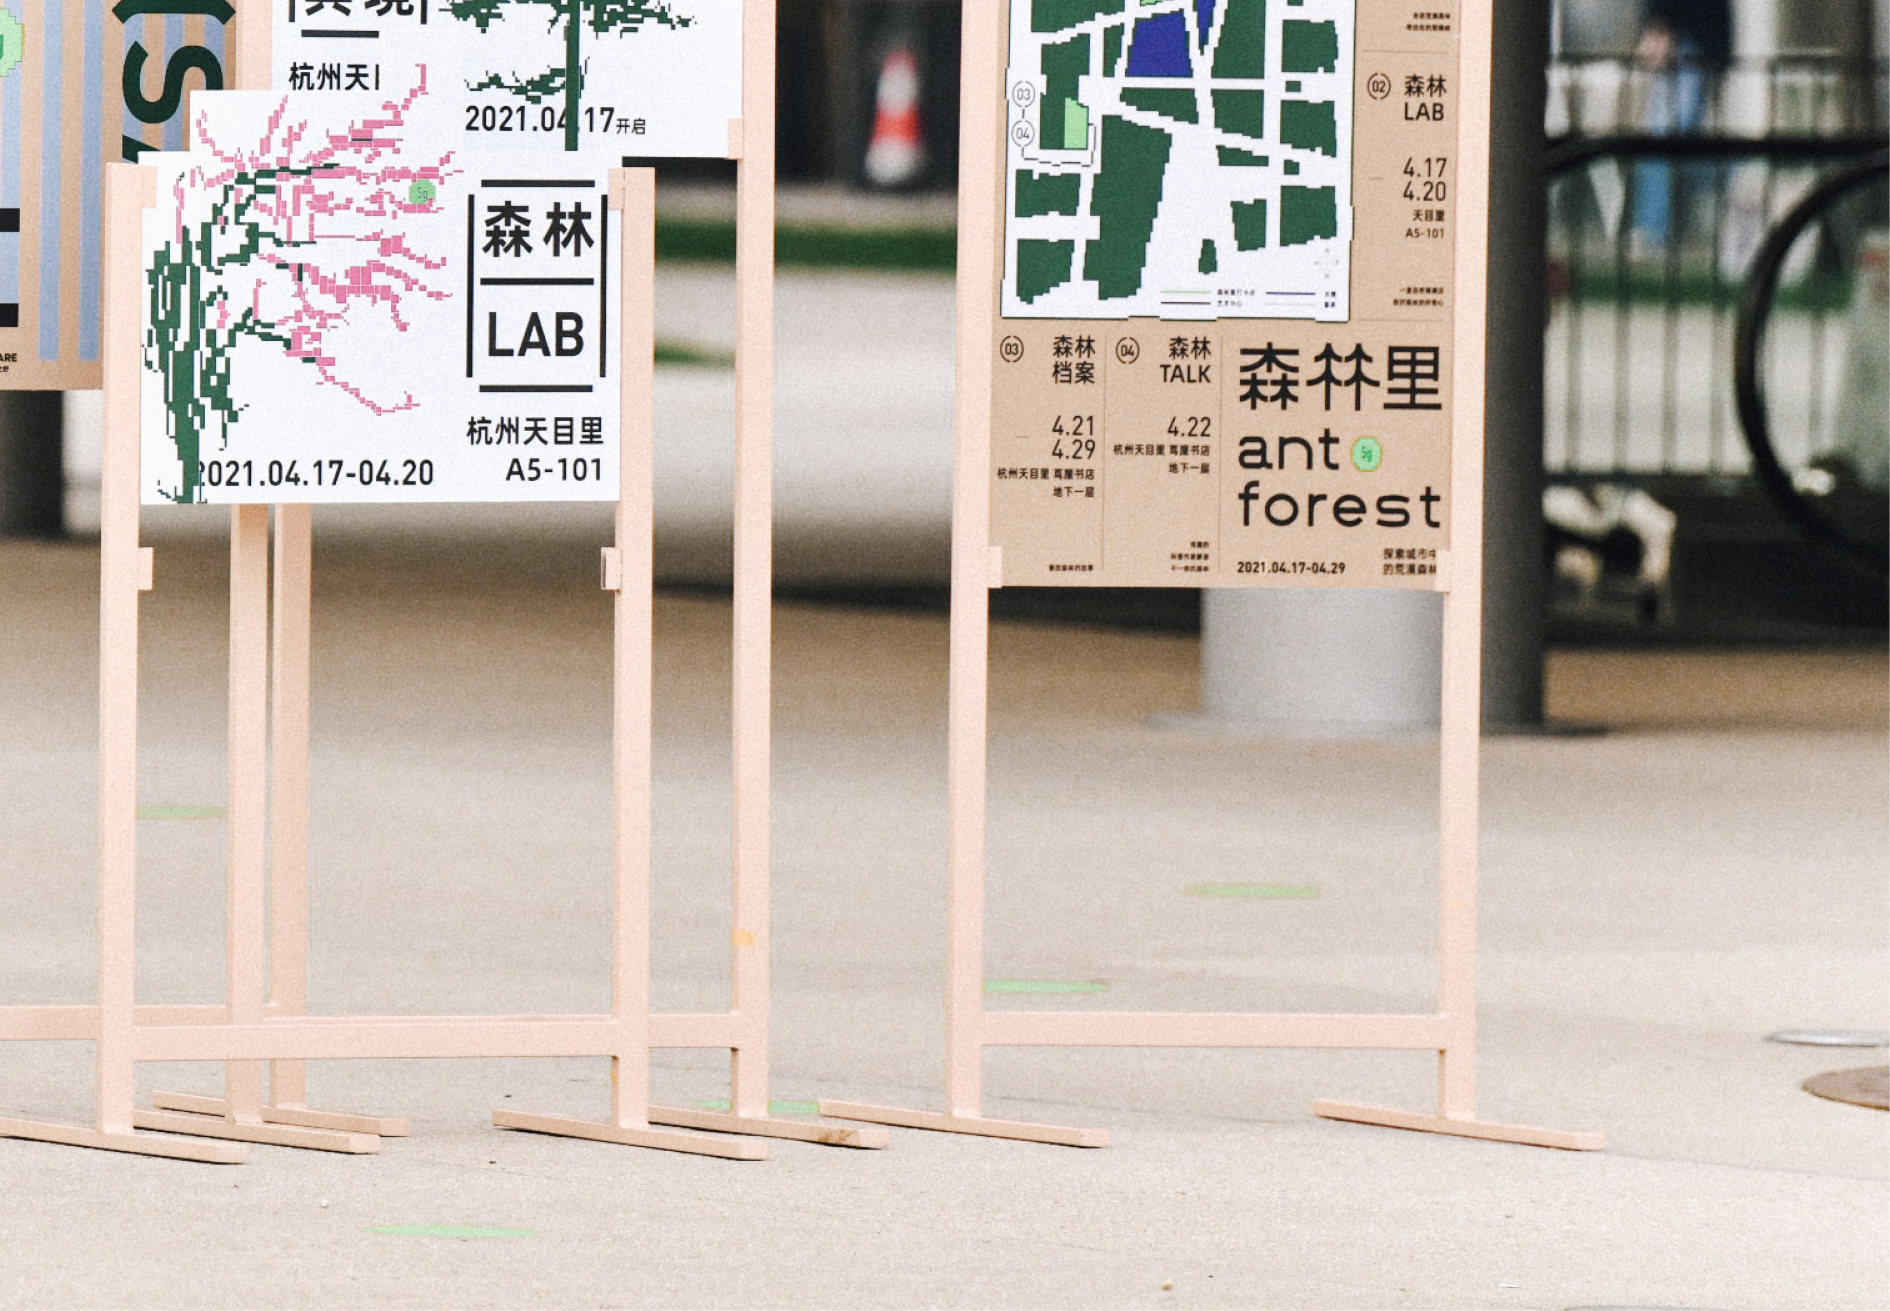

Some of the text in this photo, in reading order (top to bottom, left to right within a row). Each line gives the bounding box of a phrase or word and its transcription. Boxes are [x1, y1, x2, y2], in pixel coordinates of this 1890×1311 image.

[287, 62, 380, 89] 杭州天
[1405, 74, 1446, 97] 森林
[1016, 88, 1031, 100] 03
[1371, 81, 1386, 93] 02
[465, 105, 647, 135] 2021.017开启
[1404, 102, 1444, 121] LAB
[1015, 127, 1030, 139] 04
[1403, 157, 1447, 177] 4.17
[1403, 181, 1446, 201] 4.20
[482, 201, 594, 257] 森林
[1405, 228, 1444, 238] A5-101
[489, 312, 584, 356] LAB
[1004, 342, 1019, 356] 03
[1053, 335, 1095, 358] 森林
[1120, 344, 1135, 357] 04
[1169, 336, 1211, 359] 森林
[1052, 361, 1094, 384] 档案
[1160, 364, 1210, 383] TALK
[1239, 342, 1442, 411] 森林里
[467, 417, 603, 445] 杭州天目里
[1052, 415, 1093, 436] 4.21
[1167, 416, 1211, 437] 4.22
[1052, 439, 1095, 459] 4.29
[1114, 444, 1164, 455] 杭州天目里
[1239, 428, 1339, 470] ant
[506, 458, 600, 481] A5-101
[997, 468, 1049, 479] 杭州天目里
[1238, 480, 1441, 528] forest
[1237, 561, 1345, 574] 2021.04.17-04.29
